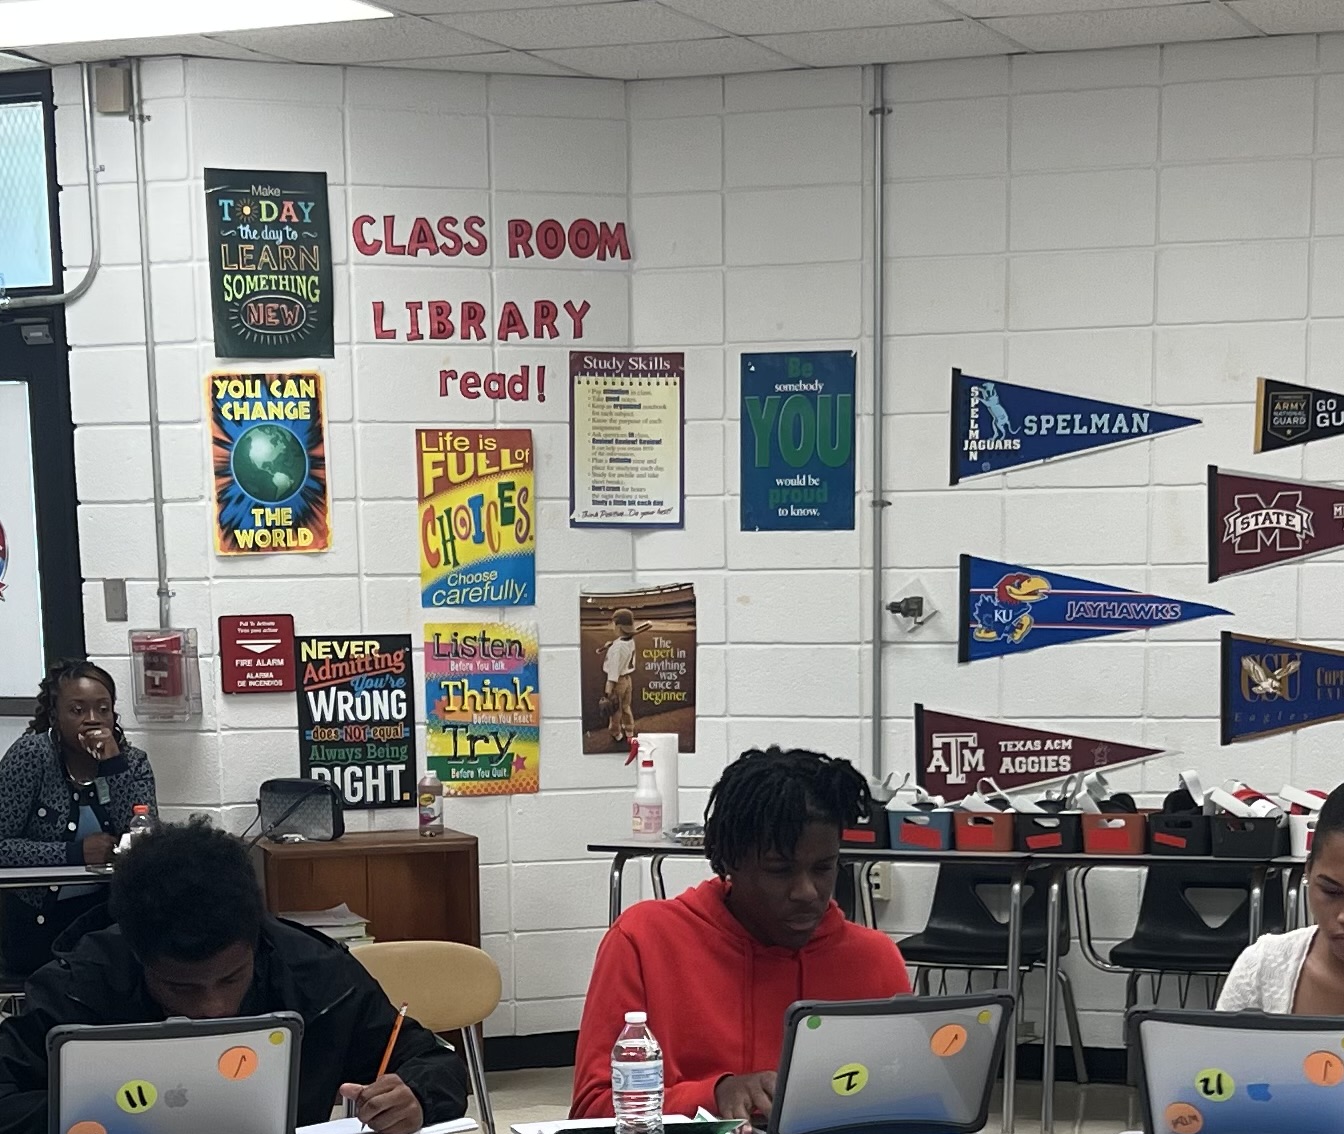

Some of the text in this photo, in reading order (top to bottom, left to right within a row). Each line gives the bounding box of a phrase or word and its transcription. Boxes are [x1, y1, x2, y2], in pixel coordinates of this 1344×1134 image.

[251, 185, 281, 197] Make
[218, 198, 315, 223] TODAY
[237, 224, 299, 245] the day to
[352, 214, 632, 261] CLASS ROOM
[221, 244, 320, 272] LEARN
[223, 274, 321, 303] SOMETHING
[246, 303, 300, 326] NEW
[372, 300, 591, 341] LIBRARY
[583, 355, 671, 373] Study Skills
[786, 356, 813, 378] Be
[214, 379, 316, 399] YOU CAN
[439, 365, 546, 402] read!
[775, 379, 824, 393] somebody
[221, 401, 311, 421] CHANGE
[1274, 401, 1306, 411] ARMY
[1316, 399, 1337, 412] GO
[744, 393, 852, 468] YOU
[967, 386, 980, 461] SPELMAN
[1024, 413, 1150, 436] SPELMAN
[1273, 416, 1306, 425] GUARD
[421, 431, 497, 452] Life is
[963, 439, 1021, 450] JAGUARS
[422, 448, 524, 498] FULL
[775, 475, 820, 487] would be
[768, 482, 828, 509] proud
[251, 507, 293, 527] THE
[778, 505, 820, 517] to know.
[1240, 511, 1296, 530] STATE
[422, 481, 534, 568] CHOICES.
[234, 528, 314, 549] WORLD
[447, 569, 497, 586] Choose
[432, 578, 528, 607] carefully.
[994, 610, 1013, 623] KU
[1065, 600, 1181, 621] JAYHAWKS
[301, 639, 380, 662] NEVER
[433, 630, 524, 660] Listen
[652, 637, 671, 648] The
[235, 658, 284, 667] FIRE ALARM
[642, 648, 686, 662] expert in
[303, 648, 405, 685] Admitting
[451, 661, 489, 672] Before You
[645, 660, 686, 675] anything
[659, 671, 678, 680] was
[350, 673, 406, 697] You're
[440, 677, 535, 712] Think
[649, 680, 680, 689] once a
[307, 687, 407, 723] WRONG
[642, 688, 687, 704] beginner.
[473, 713, 511, 725] Before You
[312, 724, 404, 742] does NOT equal
[309, 744, 409, 763] Always Being
[442, 725, 517, 766] Try
[999, 740, 1041, 753] TEXAS
[451, 768, 490, 779] Before You
[999, 755, 1071, 773] AGGIES
